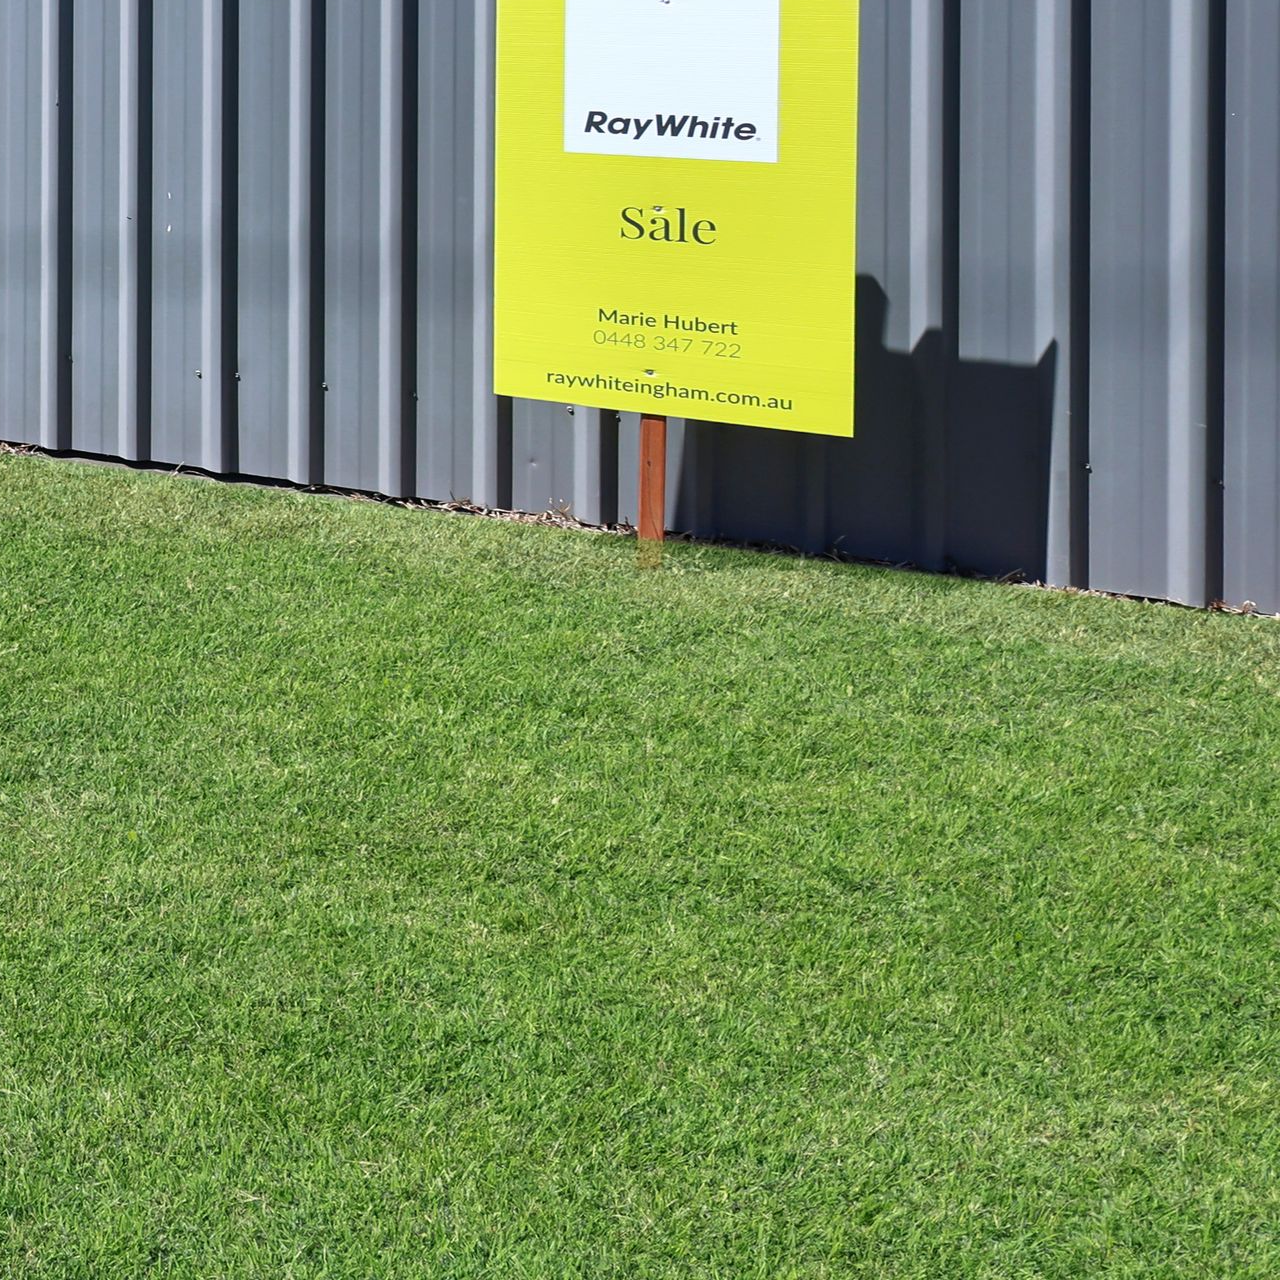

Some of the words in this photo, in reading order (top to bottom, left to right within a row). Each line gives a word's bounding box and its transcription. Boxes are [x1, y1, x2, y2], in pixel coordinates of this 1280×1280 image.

[620, 207, 717, 245] Sale
[598, 308, 657, 327] Marie
[663, 314, 739, 335] Hubert
[592, 329, 646, 349] 0448
[653, 335, 693, 353] 347
[701, 340, 742, 358] 722
[546, 371, 793, 410] raywhiteingham.com.au
